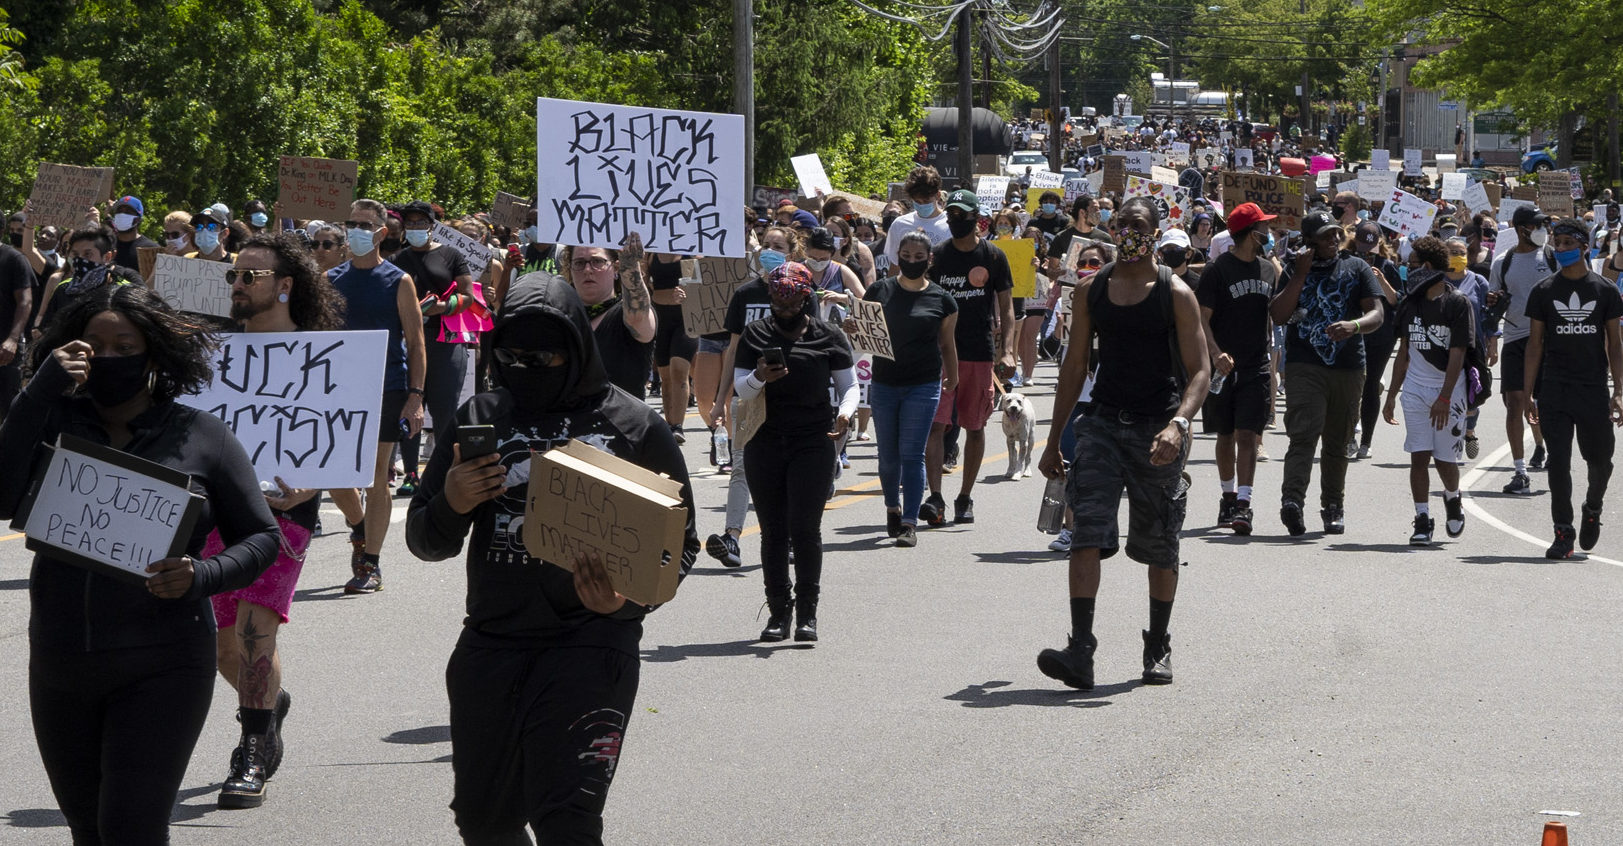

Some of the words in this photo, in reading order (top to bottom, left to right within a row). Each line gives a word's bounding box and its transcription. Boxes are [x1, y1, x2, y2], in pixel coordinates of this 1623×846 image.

[569, 110, 719, 165] BLACK
[38, 173, 61, 184] YOUR
[66, 176, 92, 187] MASK
[63, 166, 78, 176] YOU
[291, 168, 305, 182] King
[319, 171, 337, 183] MLK
[340, 173, 353, 188] Day
[1036, 172, 1059, 182] Black
[34, 183, 64, 193] MAKES
[297, 180, 321, 193] Better
[328, 184, 340, 196] Be
[566, 154, 719, 213] LIVES
[1066, 181, 1090, 192] BLACK
[1224, 175, 1277, 191] DEFUND
[1280, 180, 1302, 196] THE
[291, 192, 307, 203] Out
[314, 195, 336, 209] Here
[977, 195, 1004, 203] option
[1244, 190, 1284, 204] POLICE
[1392, 191, 1403, 202] I
[551, 198, 727, 255] MATTER
[439, 227, 454, 241] like
[456, 237, 465, 248] to
[465, 242, 490, 262] Speak
[700, 257, 760, 286] BLACK
[940, 275, 966, 287] Happy
[155, 273, 203, 293] TRUMP
[1229, 279, 1271, 298] SUPREM
[950, 289, 985, 300] Campers
[691, 306, 729, 332] MAT
[745, 308, 772, 326] BLA
[854, 320, 888, 338] IVES
[1410, 333, 1426, 341] LIVES
[1556, 323, 1597, 334] adidas
[850, 334, 894, 358] MATTER
[215, 340, 345, 400] UCK
[58, 457, 98, 496] NO
[96, 473, 181, 529] JUSTICE
[549, 467, 618, 527] BLACK
[80, 503, 111, 531] NO
[562, 502, 640, 554] LIVES
[46, 513, 153, 571] PEACE!!!
[540, 523, 633, 582] MATTER
